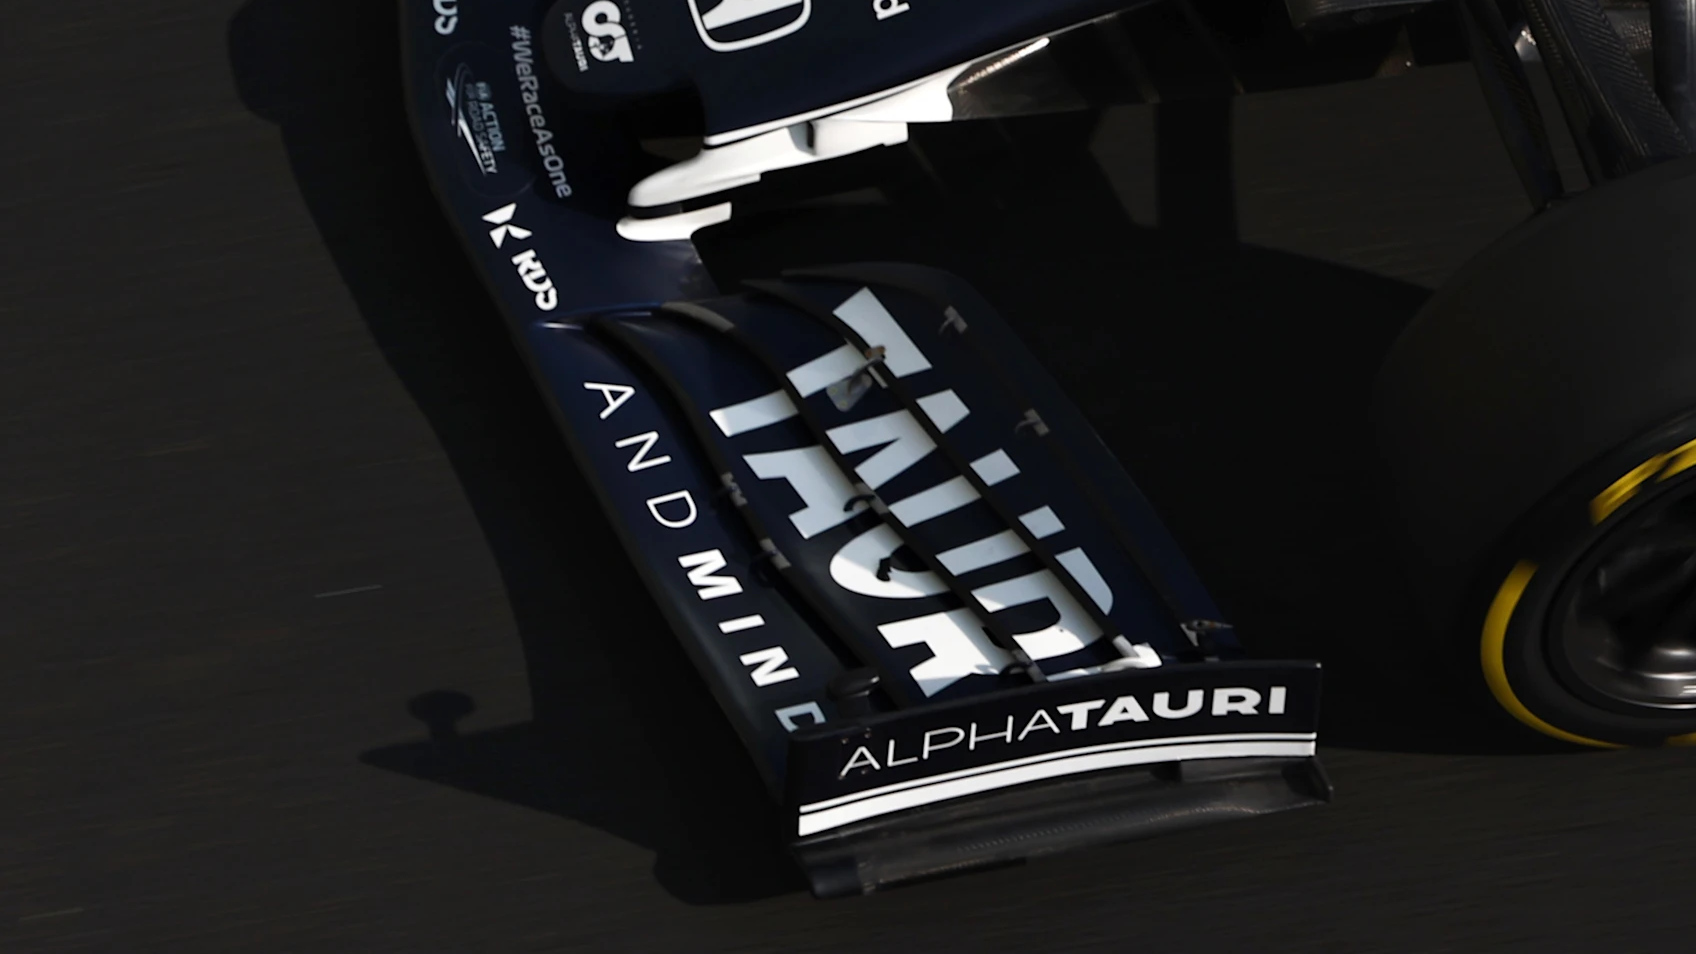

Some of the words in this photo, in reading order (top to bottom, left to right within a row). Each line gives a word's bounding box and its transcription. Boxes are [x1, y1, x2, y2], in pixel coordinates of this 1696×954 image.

[480, 102, 506, 152] ACTION
[509, 24, 573, 198] #WeRaceAsOne
[511, 248, 559, 312] RDS
[583, 381, 699, 529] AND
[838, 685, 1288, 781] ALPHATAURI
